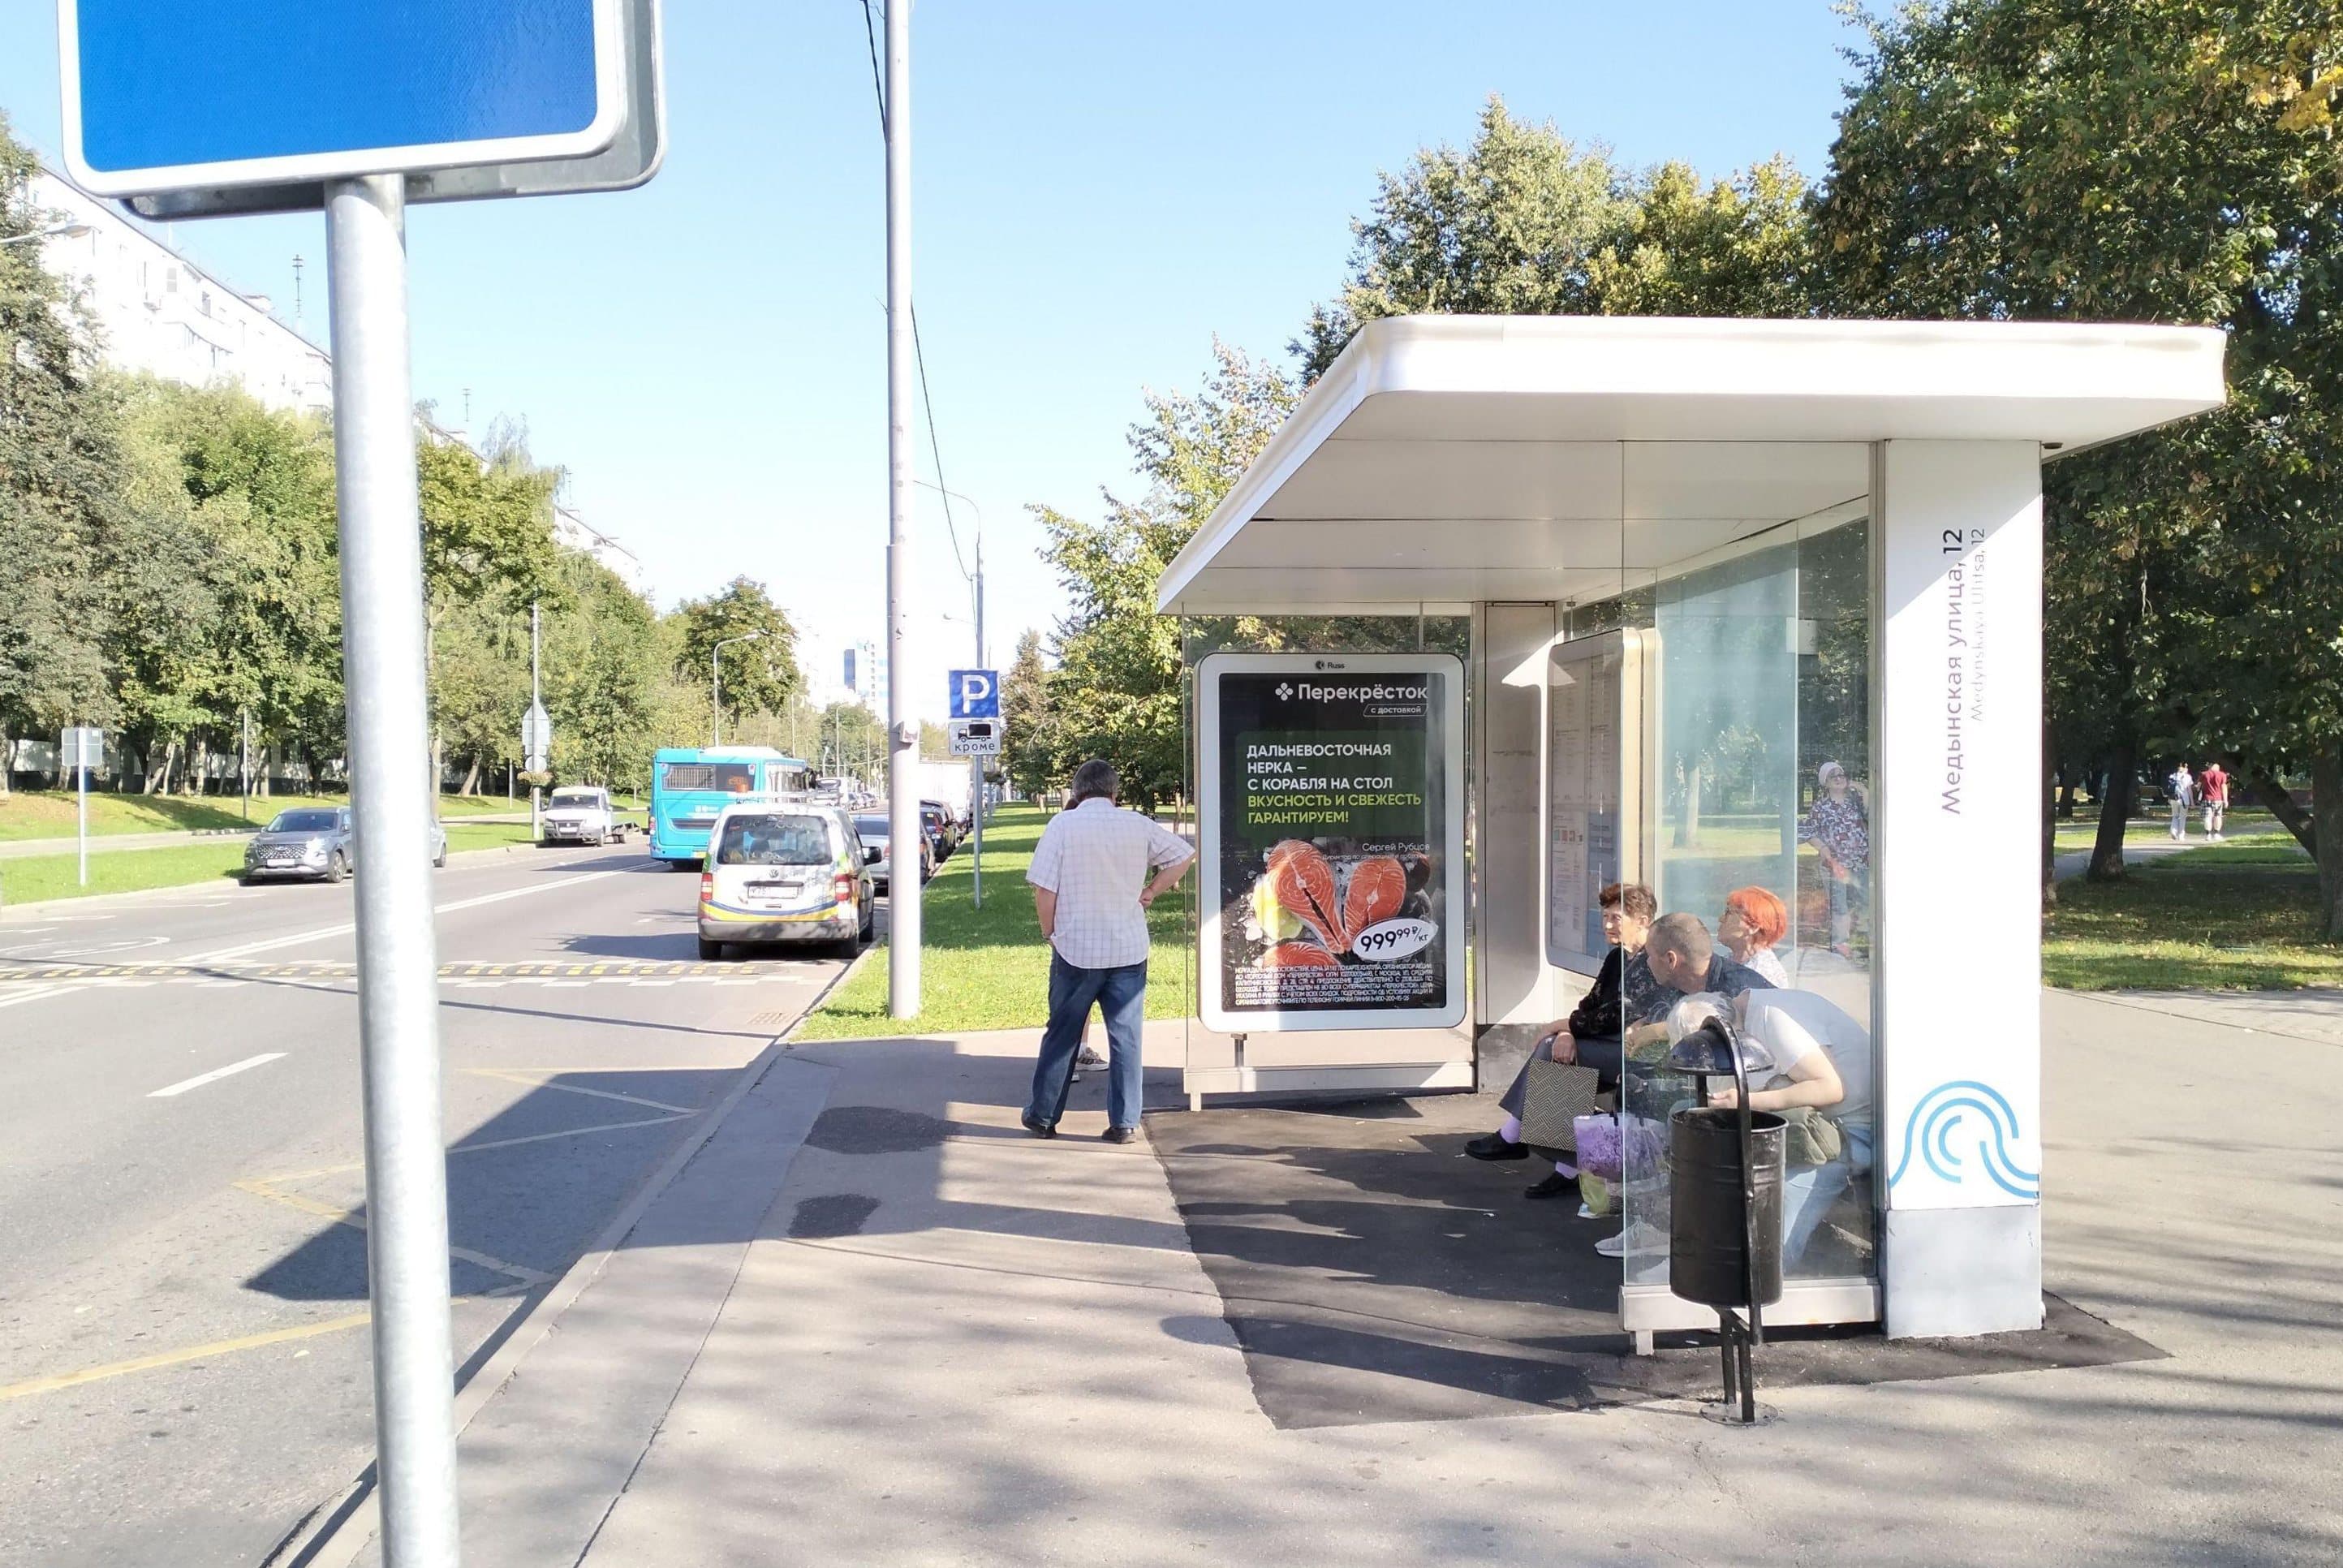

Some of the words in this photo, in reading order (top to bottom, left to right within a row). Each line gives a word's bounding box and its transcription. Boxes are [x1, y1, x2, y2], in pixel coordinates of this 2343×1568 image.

[1942, 528, 1963, 555] 12
[1970, 528, 1985, 545] 12
[1947, 562, 1967, 648] улица,
[1298, 683, 1428, 704] Перекрёсток
[1377, 705, 1422, 715] доставкой
[1941, 657, 1965, 816] Медынская
[954, 743, 995, 753] кроме
[1246, 743, 1392, 758] ДАЛЬНЕВОСТОЧНАЯ
[1247, 762, 1293, 774] НЕРКА
[1247, 778, 1258, 791] С
[1262, 778, 1327, 791] КОРАБЛЯ
[1331, 778, 1350, 790] НА
[1353, 777, 1393, 790] СТОЛ
[1247, 795, 1331, 808] ВКУСНОСТЬ
[1335, 795, 1345, 807] И
[1348, 793, 1421, 807] СВЕЖЕСТЬ
[1247, 811, 1349, 825] ГАРАНТИРУЕМ!
[1362, 842, 1397, 852] Сергей
[1398, 842, 1431, 852] Рубцов
